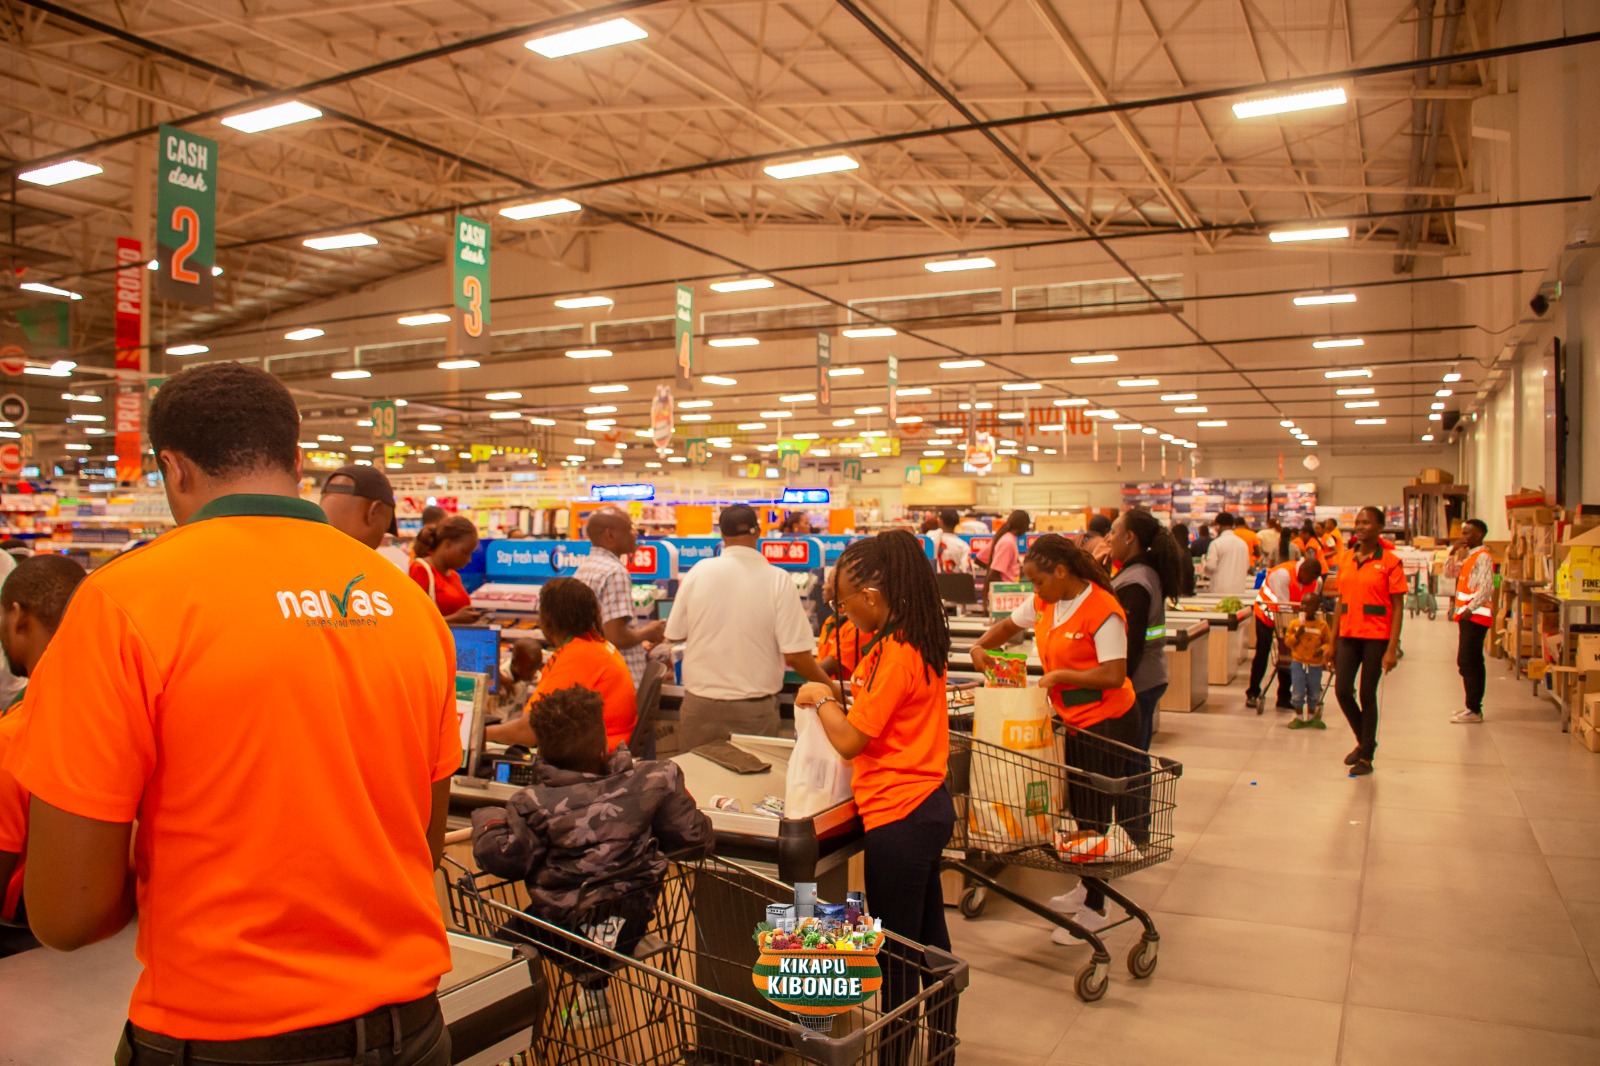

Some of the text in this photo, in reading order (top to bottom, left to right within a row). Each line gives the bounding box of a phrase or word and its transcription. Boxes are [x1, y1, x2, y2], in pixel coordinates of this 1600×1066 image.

[166, 135, 208, 171] CASH
[168, 166, 208, 192] desk
[171, 205, 200, 285] 2
[460, 221, 486, 249] CASH
[117, 247, 141, 315] PROMO
[463, 275, 483, 337] 3
[372, 406, 395, 438] 39
[687, 441, 706, 464] 45
[497, 549, 587, 573] Stay fresh with Orbi
[764, 540, 805, 559] naivas
[276, 573, 394, 619] naivas
[349, 618, 378, 628] money
